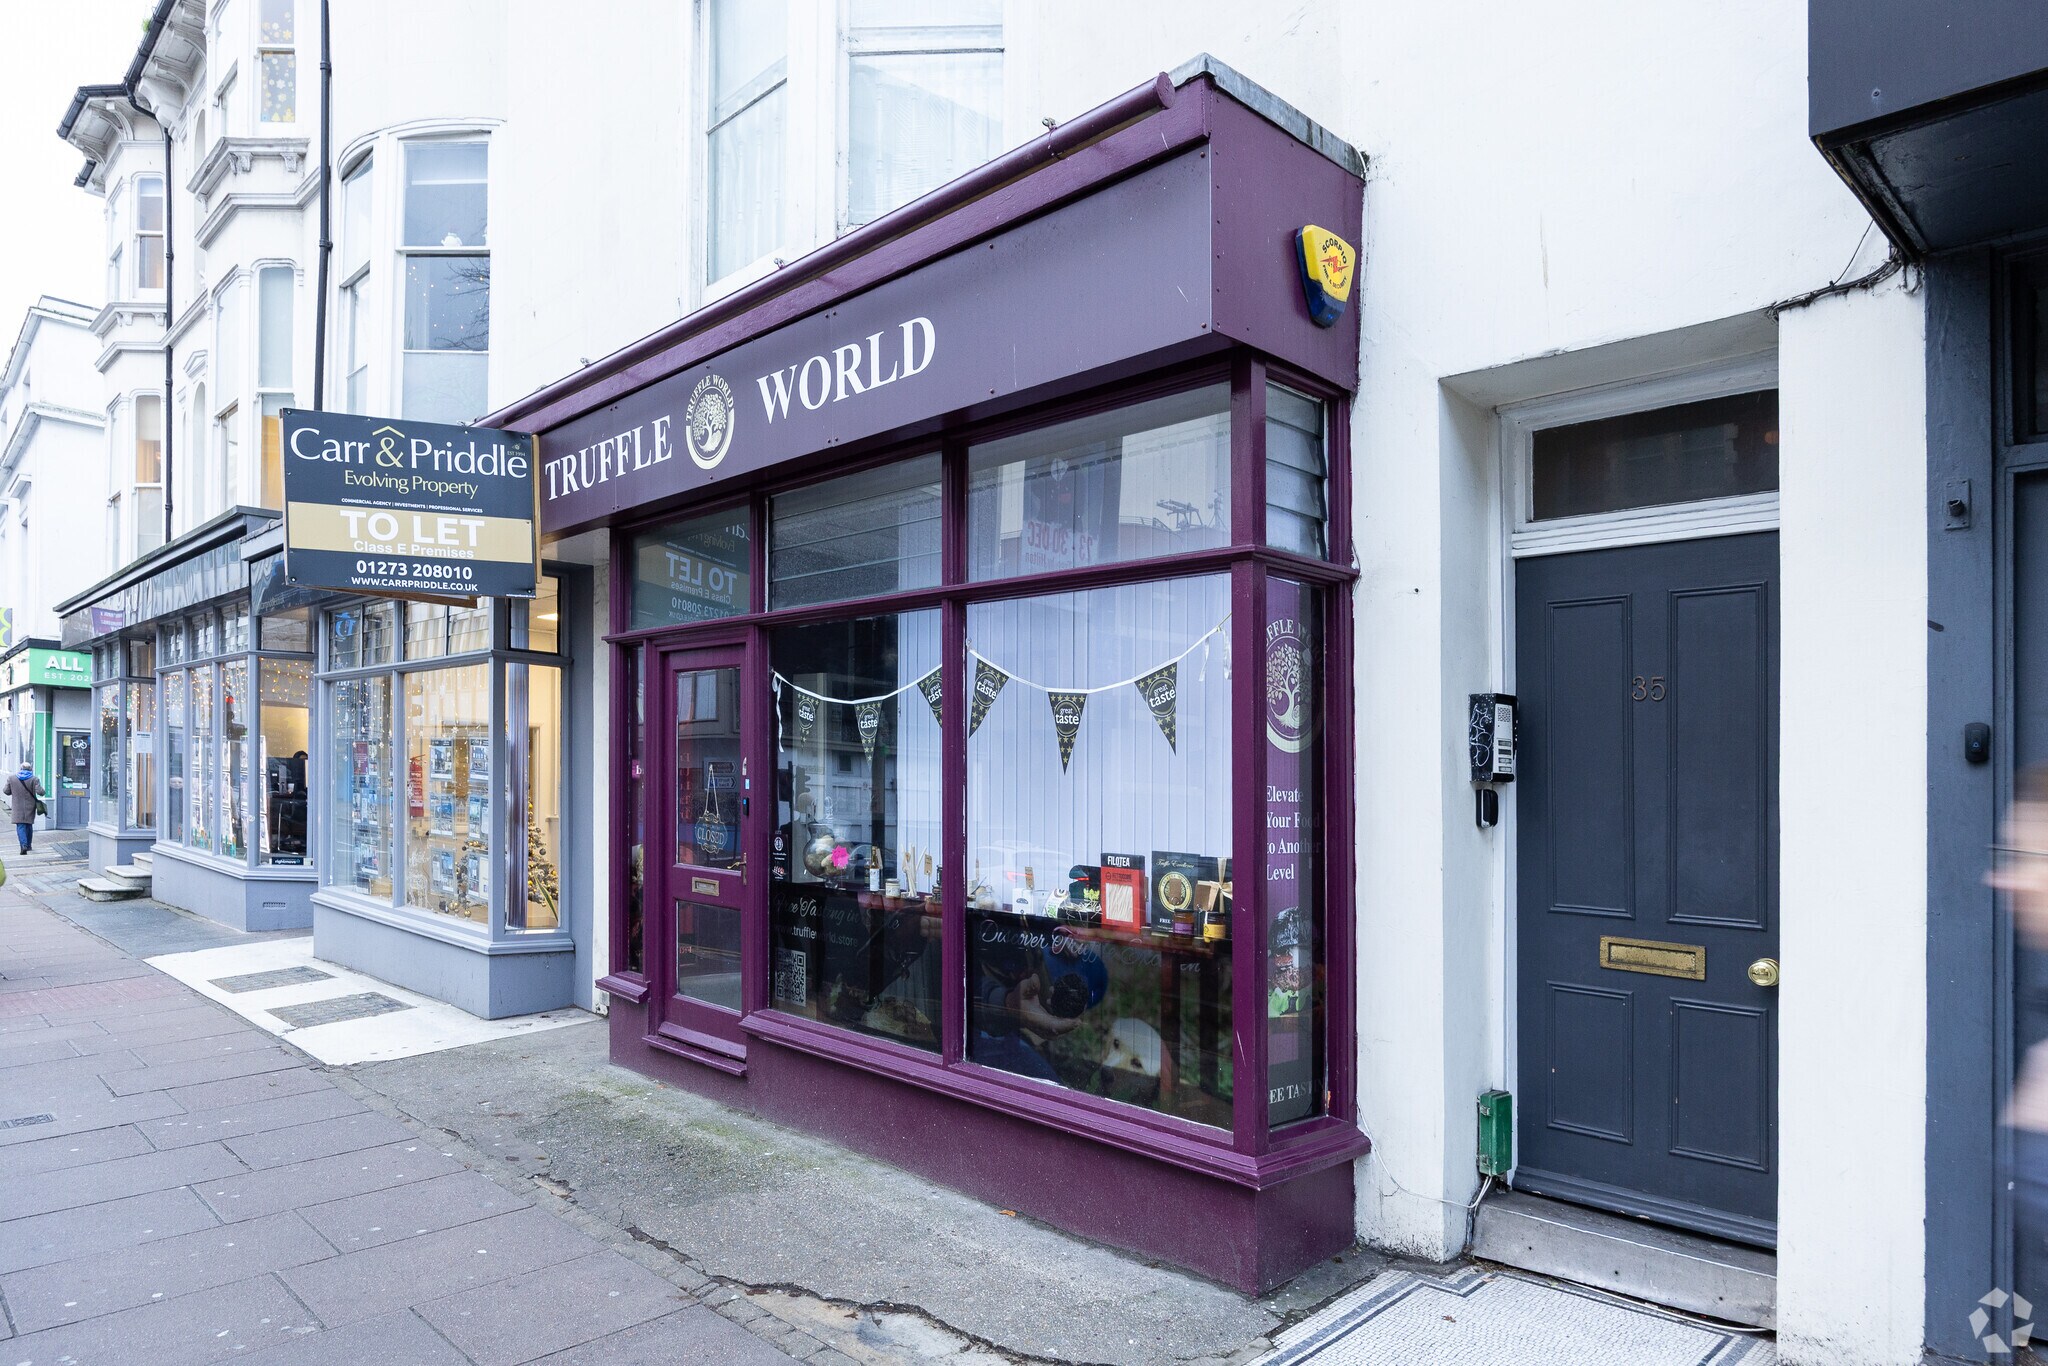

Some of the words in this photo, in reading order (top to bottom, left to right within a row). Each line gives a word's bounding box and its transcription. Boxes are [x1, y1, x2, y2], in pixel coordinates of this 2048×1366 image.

[1322, 238, 1347, 264] SCORPIO
[686, 375, 711, 421] TRUFFLE
[712, 374, 734, 408] WORLD
[544, 415, 673, 501] TRUFFLE
[756, 317, 936, 424] WORLD
[290, 427, 371, 465] Carr
[375, 437, 404, 468] &
[410, 438, 528, 479] Priddle
[344, 470, 409, 494] Evolving
[412, 475, 479, 499] Property
[341, 497, 372, 505] COMMERCIAL
[428, 504, 462, 512] PROFESSIONAL
[339, 510, 399, 541] TO
[413, 515, 485, 547] LET
[353, 540, 393, 554] Class
[397, 543, 407, 555] E
[411, 544, 474, 559] Premises
[356, 560, 408, 576] 01273
[412, 563, 473, 580] 208010
[351, 576, 478, 592] WWW.CARRPRIDDLE.CO.UK
[1266, 619, 1294, 641] FFLE
[45, 655, 84, 672] ALL
[44, 672, 66, 680] EST.
[70, 674, 92, 682] 202
[983, 678, 995, 687] great
[976, 682, 997, 700] taste
[1153, 683, 1169, 696] great
[1632, 676, 1666, 701] 35
[1149, 690, 1177, 708] taste
[864, 714, 874, 722] great
[1055, 714, 1079, 725] taste
[1060, 707, 1073, 715] great
[860, 718, 878, 729] taste
[1267, 785, 1304, 803] Elevate
[1267, 811, 1292, 828] Your
[697, 827, 725, 845] CLOSED
[1107, 855, 1131, 867] FILOTEA
[1267, 863, 1294, 881] Level
[1269, 1087, 1285, 1104] EE
